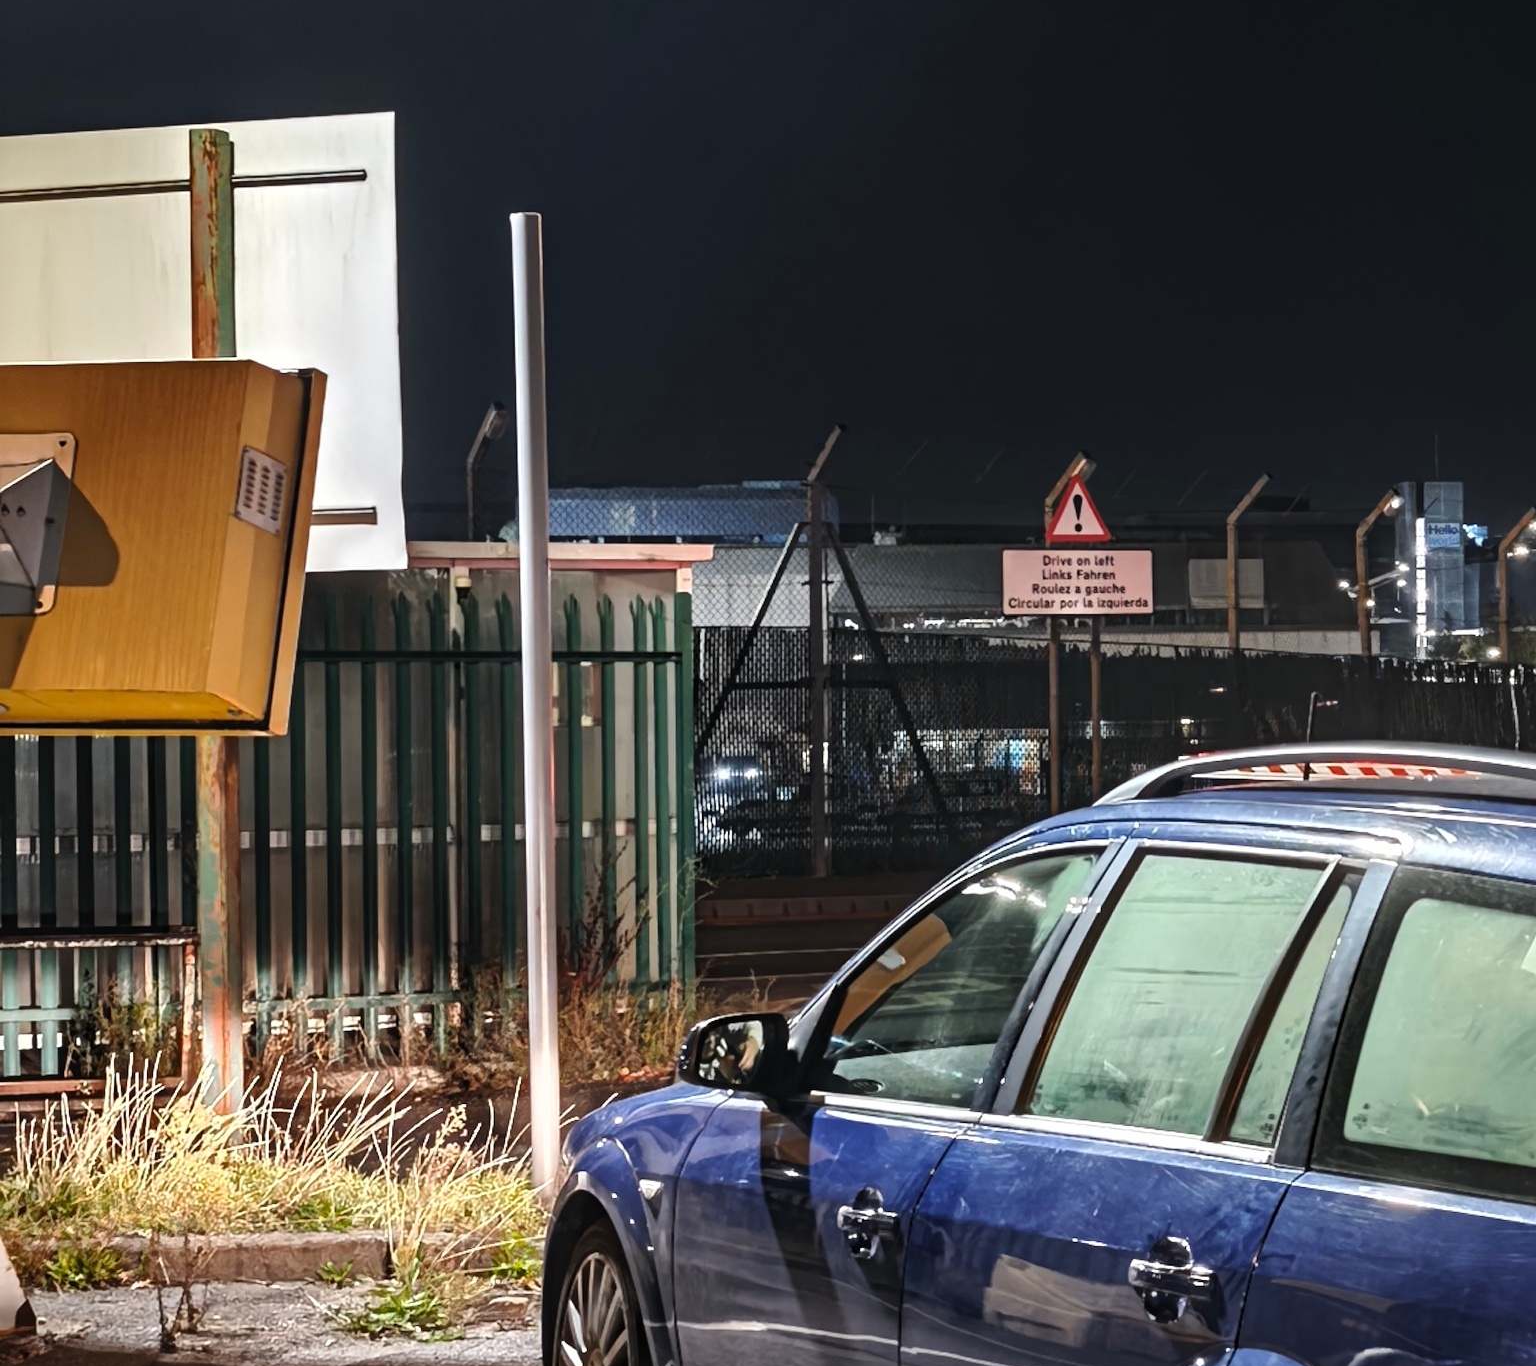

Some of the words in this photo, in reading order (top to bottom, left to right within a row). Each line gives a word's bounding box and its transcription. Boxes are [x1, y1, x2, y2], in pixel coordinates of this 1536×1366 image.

[1428, 524, 1459, 535] Hello
[1042, 554, 1073, 566] Drive
[1076, 556, 1091, 566] on
[1094, 554, 1115, 566] left
[1042, 569, 1072, 580] Links
[1076, 568, 1116, 580] Fahren
[1032, 583, 1071, 595] Roulez
[1074, 586, 1082, 595] a
[1085, 582, 1126, 596] gauche
[1008, 597, 1056, 609] Circular
[1060, 599, 1079, 610] por
[1083, 597, 1094, 608] la
[1097, 596, 1149, 610] izquierda
